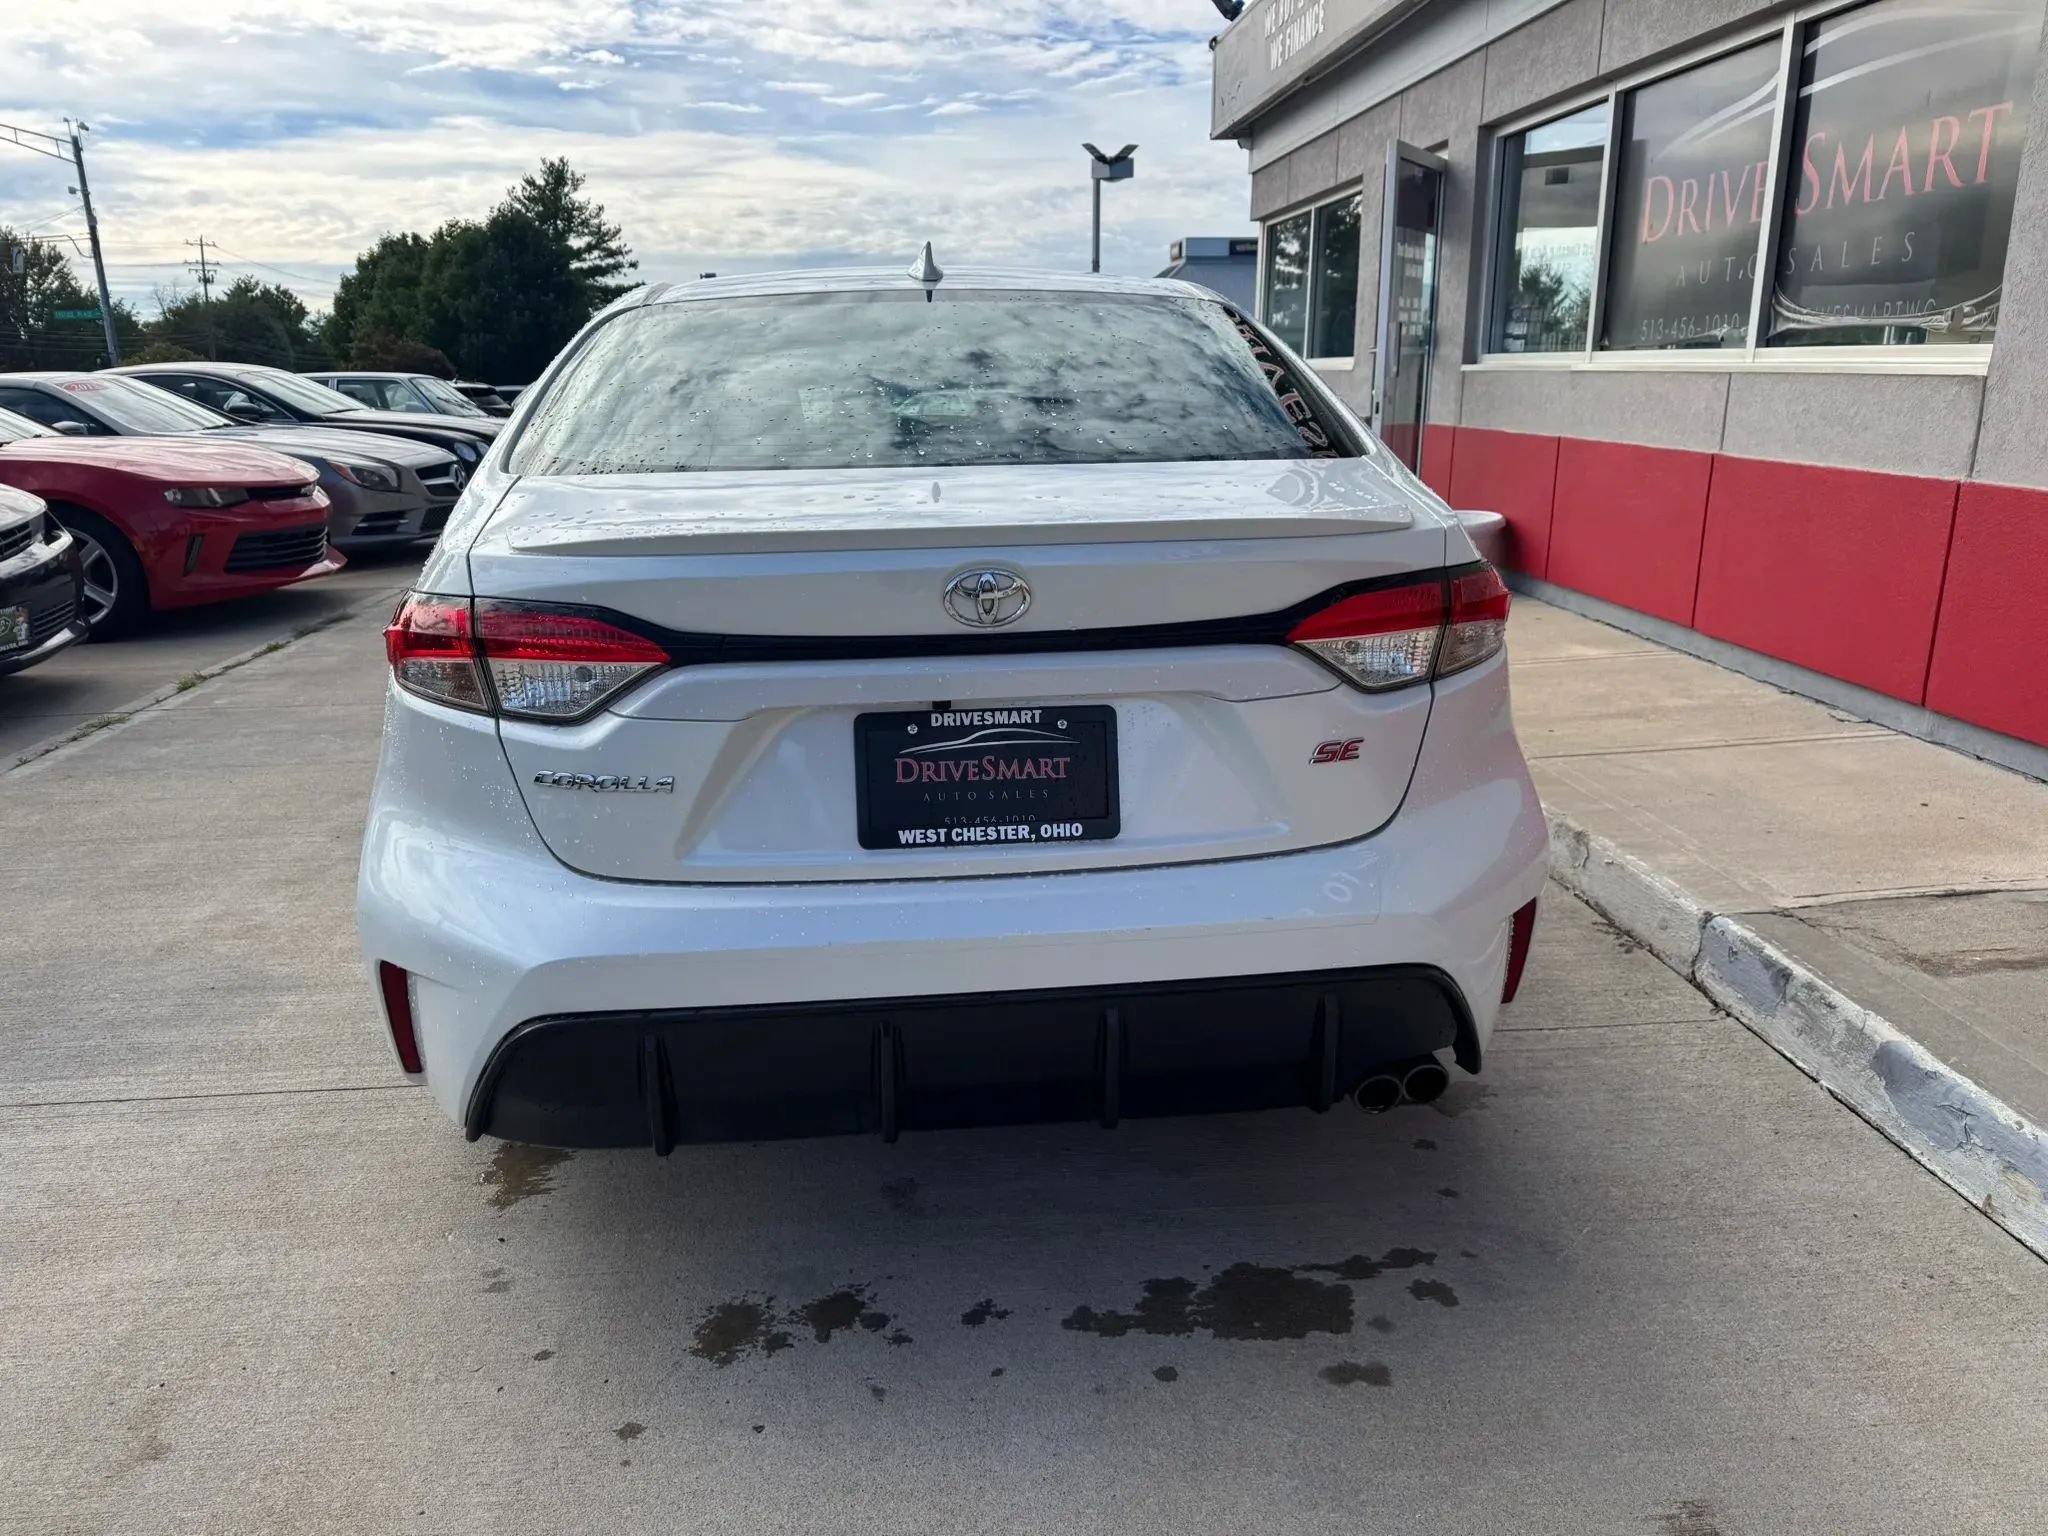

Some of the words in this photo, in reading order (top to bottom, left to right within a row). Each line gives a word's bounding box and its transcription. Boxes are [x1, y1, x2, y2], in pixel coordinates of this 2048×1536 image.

[1270, 33, 1283, 71] WE
[1285, 0, 1325, 61] FINANCE
[1785, 231, 1916, 275] SALES
[930, 709, 1042, 727] DRIVESMART
[1308, 737, 1365, 764] SE
[533, 770, 676, 794] COROLLA
[923, 791, 977, 802] AUTO
[989, 789, 1049, 801] SALES
[898, 828, 948, 844] WEST
[951, 825, 1036, 842] CHESTER,
[1040, 822, 1083, 838] OHIO
